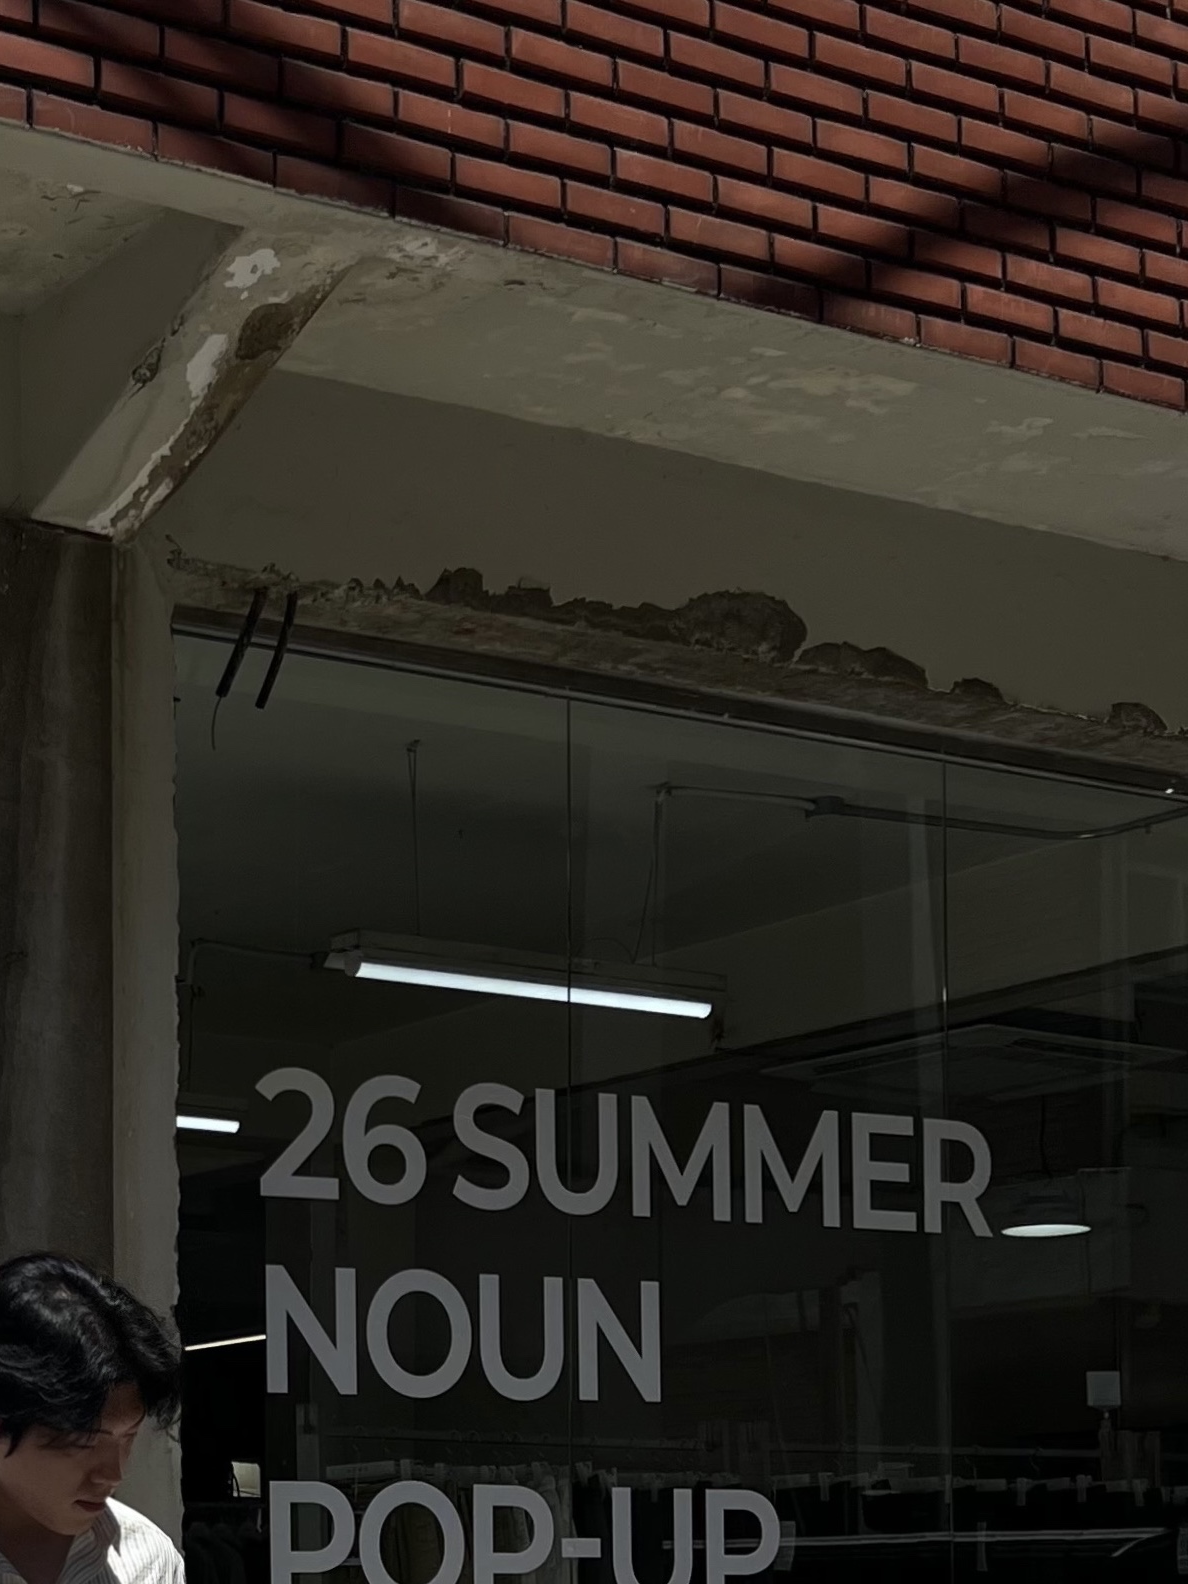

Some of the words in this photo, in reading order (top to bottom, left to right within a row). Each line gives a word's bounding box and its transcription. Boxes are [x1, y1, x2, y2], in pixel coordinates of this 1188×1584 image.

[255, 1067, 427, 1205] 26
[452, 1082, 994, 1238] SUMMER
[265, 1264, 662, 1403] NOUN
